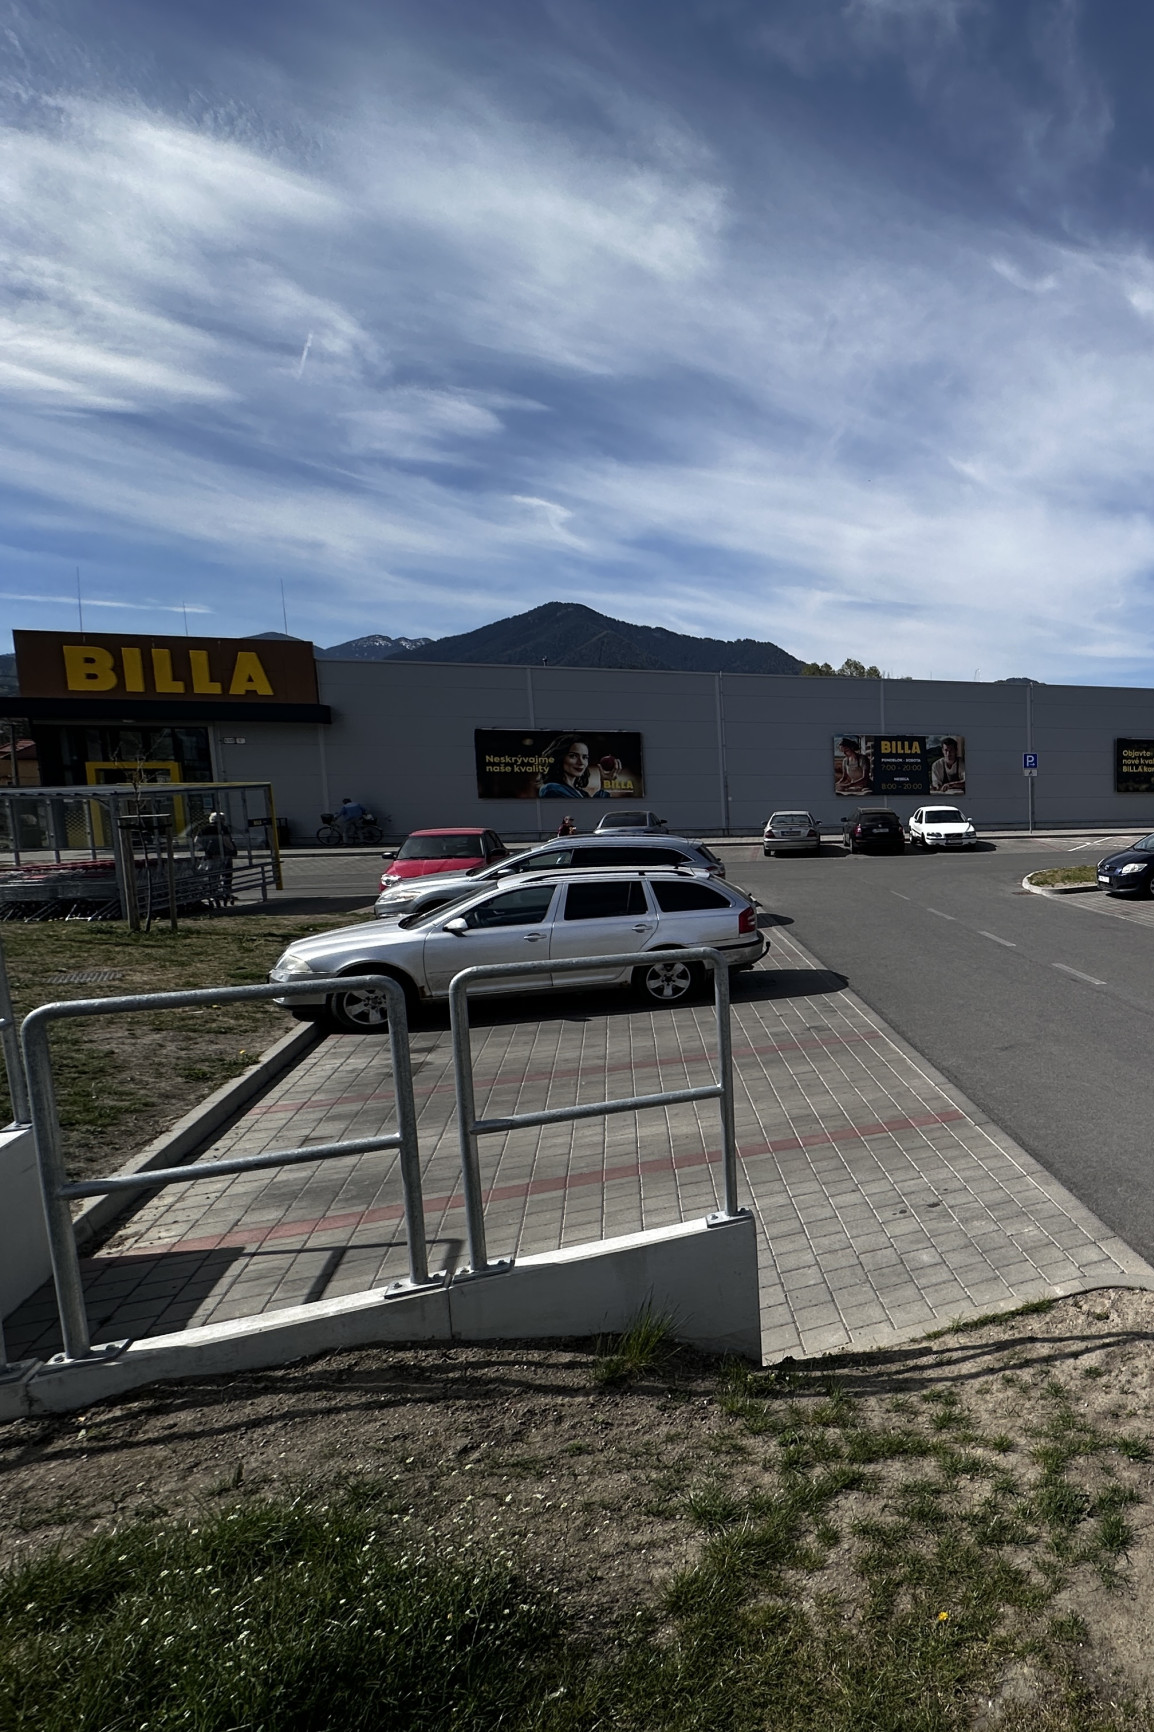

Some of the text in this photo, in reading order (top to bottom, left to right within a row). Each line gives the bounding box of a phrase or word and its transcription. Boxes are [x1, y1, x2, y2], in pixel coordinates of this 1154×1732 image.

[62, 645, 275, 696] BILLA
[881, 741, 921, 753] BILLA
[1122, 749, 1151, 758] Objavte
[485, 754, 555, 765] Neskrývajme
[1026, 755, 1035, 766] P
[486, 764, 550, 774] naše kvality
[603, 780, 634, 789] BILLA
